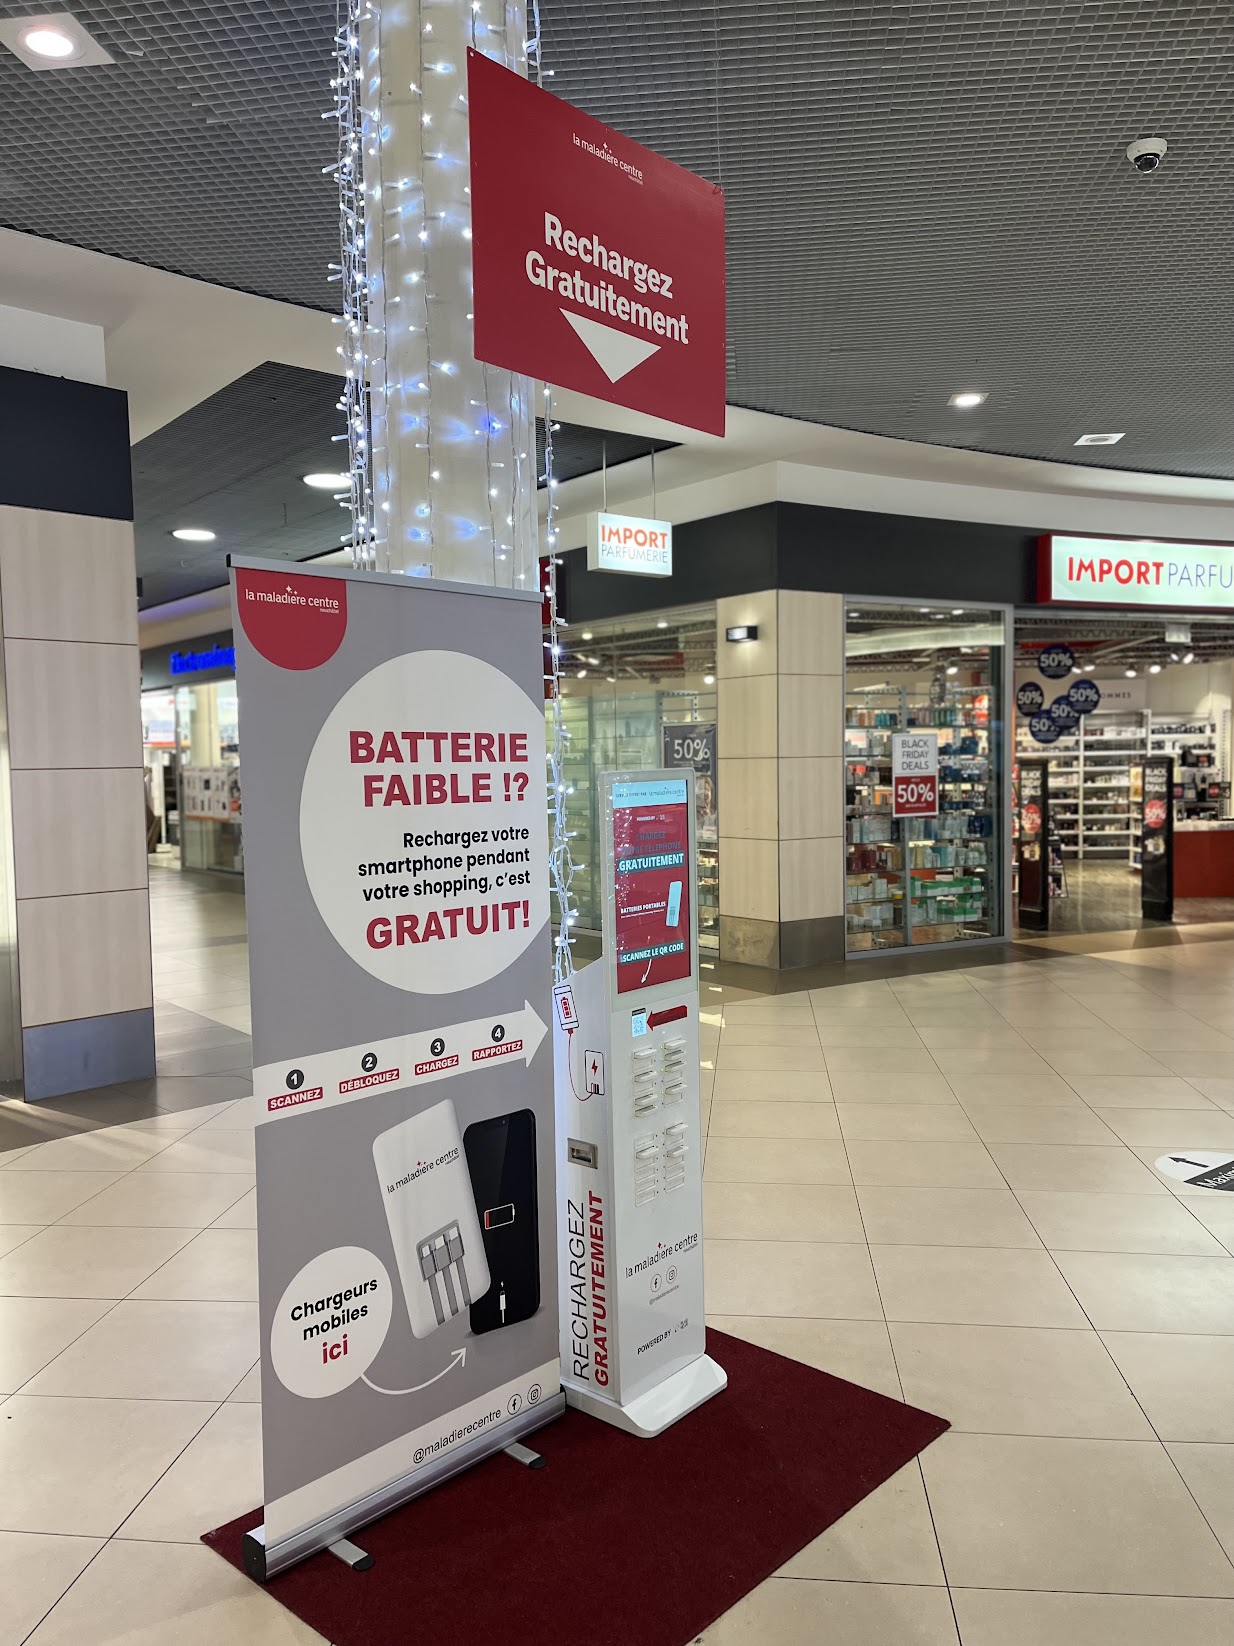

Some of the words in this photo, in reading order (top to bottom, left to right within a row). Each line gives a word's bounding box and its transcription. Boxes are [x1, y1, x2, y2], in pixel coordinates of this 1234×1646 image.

[572, 132, 581, 147] la
[619, 160, 643, 180] centre
[544, 211, 674, 300] Rechargez
[525, 250, 690, 345] Gratuitement
[601, 524, 668, 550] IMPORT
[601, 544, 668, 564] PARFUMERIE
[1068, 556, 1164, 586] IMPORT
[245, 588, 255, 600] la
[308, 597, 339, 609] centre
[1039, 653, 1073, 667] 50%
[1017, 690, 1043, 704] 50%
[1069, 688, 1099, 702] 50%
[349, 730, 529, 764] BATTERIE
[673, 738, 710, 759] 50%
[901, 739, 929, 749] BLACK
[902, 750, 930, 759] FRIDAY
[901, 760, 930, 771] DEALS
[1021, 770, 1042, 779] BLACK
[1145, 767, 1168, 776] BLACK
[363, 772, 493, 808] FAIBLE
[503, 771, 530, 802] !?
[897, 783, 934, 804] 50%
[1145, 783, 1168, 792] DEALS
[1144, 808, 1167, 820] 50%
[403, 830, 489, 849] Rechargez
[491, 826, 530, 843] votre
[635, 831, 666, 842] CHARGEZ
[357, 853, 463, 877] smartphone
[466, 847, 531, 868] pendant
[618, 853, 684, 872] GRATUITEMENT
[362, 883, 410, 902] votre
[413, 873, 493, 898] shopping,
[366, 899, 531, 951] GRATUIT!
[622, 949, 651, 963] SCANNEZ
[651, 948, 658, 956] LE
[659, 946, 668, 956] QR
[668, 942, 684, 952] CODE
[494, 1028, 502, 1039] 4
[433, 1041, 442, 1053] 3
[473, 1041, 522, 1060] RAPPORTEZ
[365, 1057, 374, 1068] 2
[416, 1056, 458, 1074] CHARGEZ
[290, 1073, 299, 1085] 1
[340, 1070, 398, 1093] DÉBLOQUEZ
[270, 1089, 321, 1110] SCANNEZ
[386, 1184, 395, 1194] la
[435, 1147, 459, 1166] centre
[625, 1266, 633, 1279] la
[674, 1233, 698, 1252] centre
[567, 1199, 590, 1382] RECHARGEZ
[588, 1190, 609, 1387] GRATUITEMENT
[290, 1277, 379, 1322] Chargeurs
[303, 1303, 369, 1341] mobiles
[322, 1333, 349, 1364] ici
[637, 1333, 664, 1355] POWERED
[664, 1328, 672, 1339] BY
[412, 1407, 502, 1465] @maladierecentre
